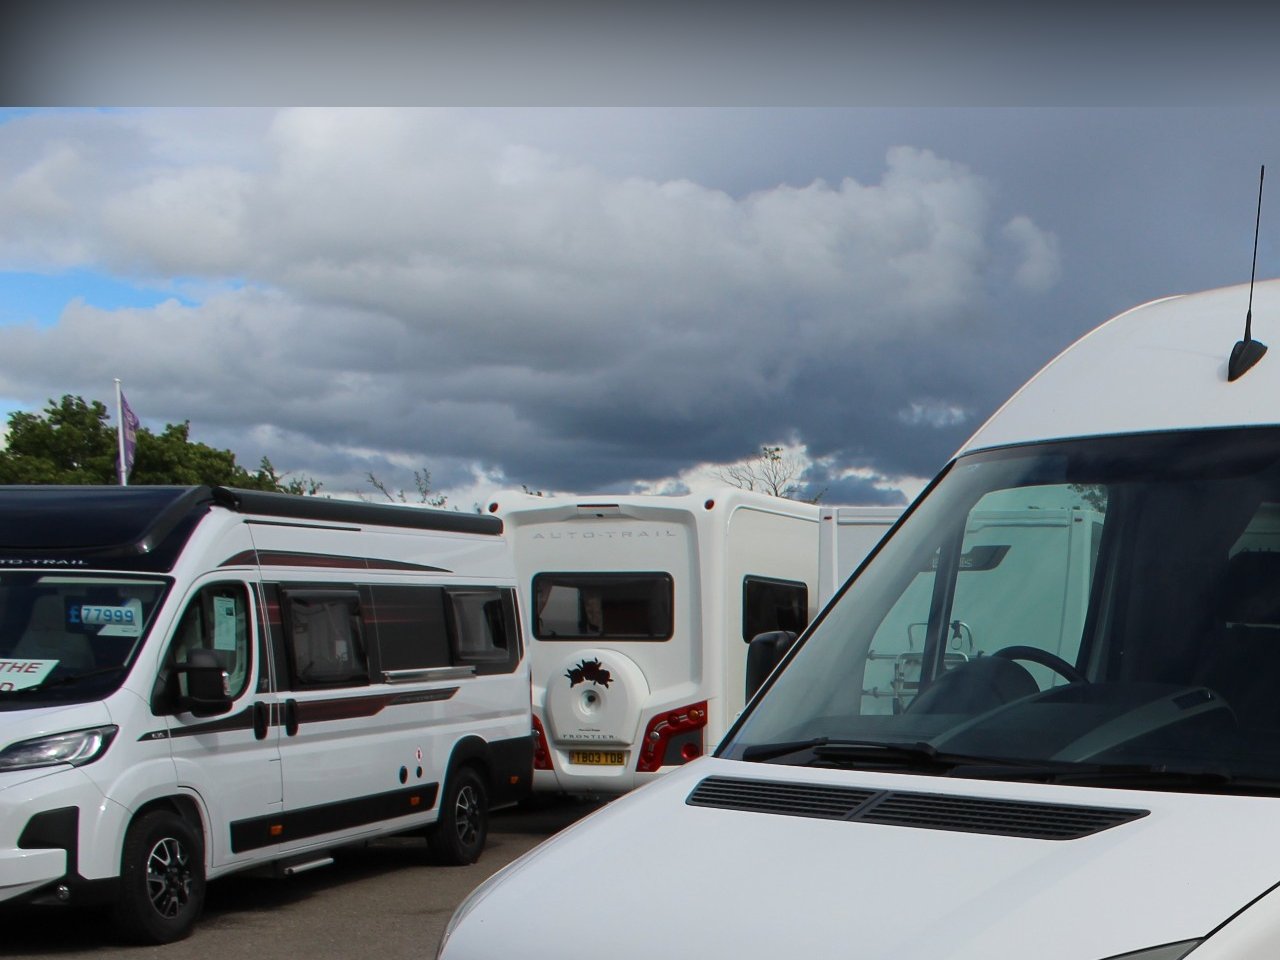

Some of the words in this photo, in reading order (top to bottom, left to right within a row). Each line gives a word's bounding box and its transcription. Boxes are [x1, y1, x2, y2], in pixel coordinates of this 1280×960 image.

[533, 530, 676, 540] AUTO-TRAIL
[69, 606, 135, 624] £77999
[0, 661, 43, 674] THE
